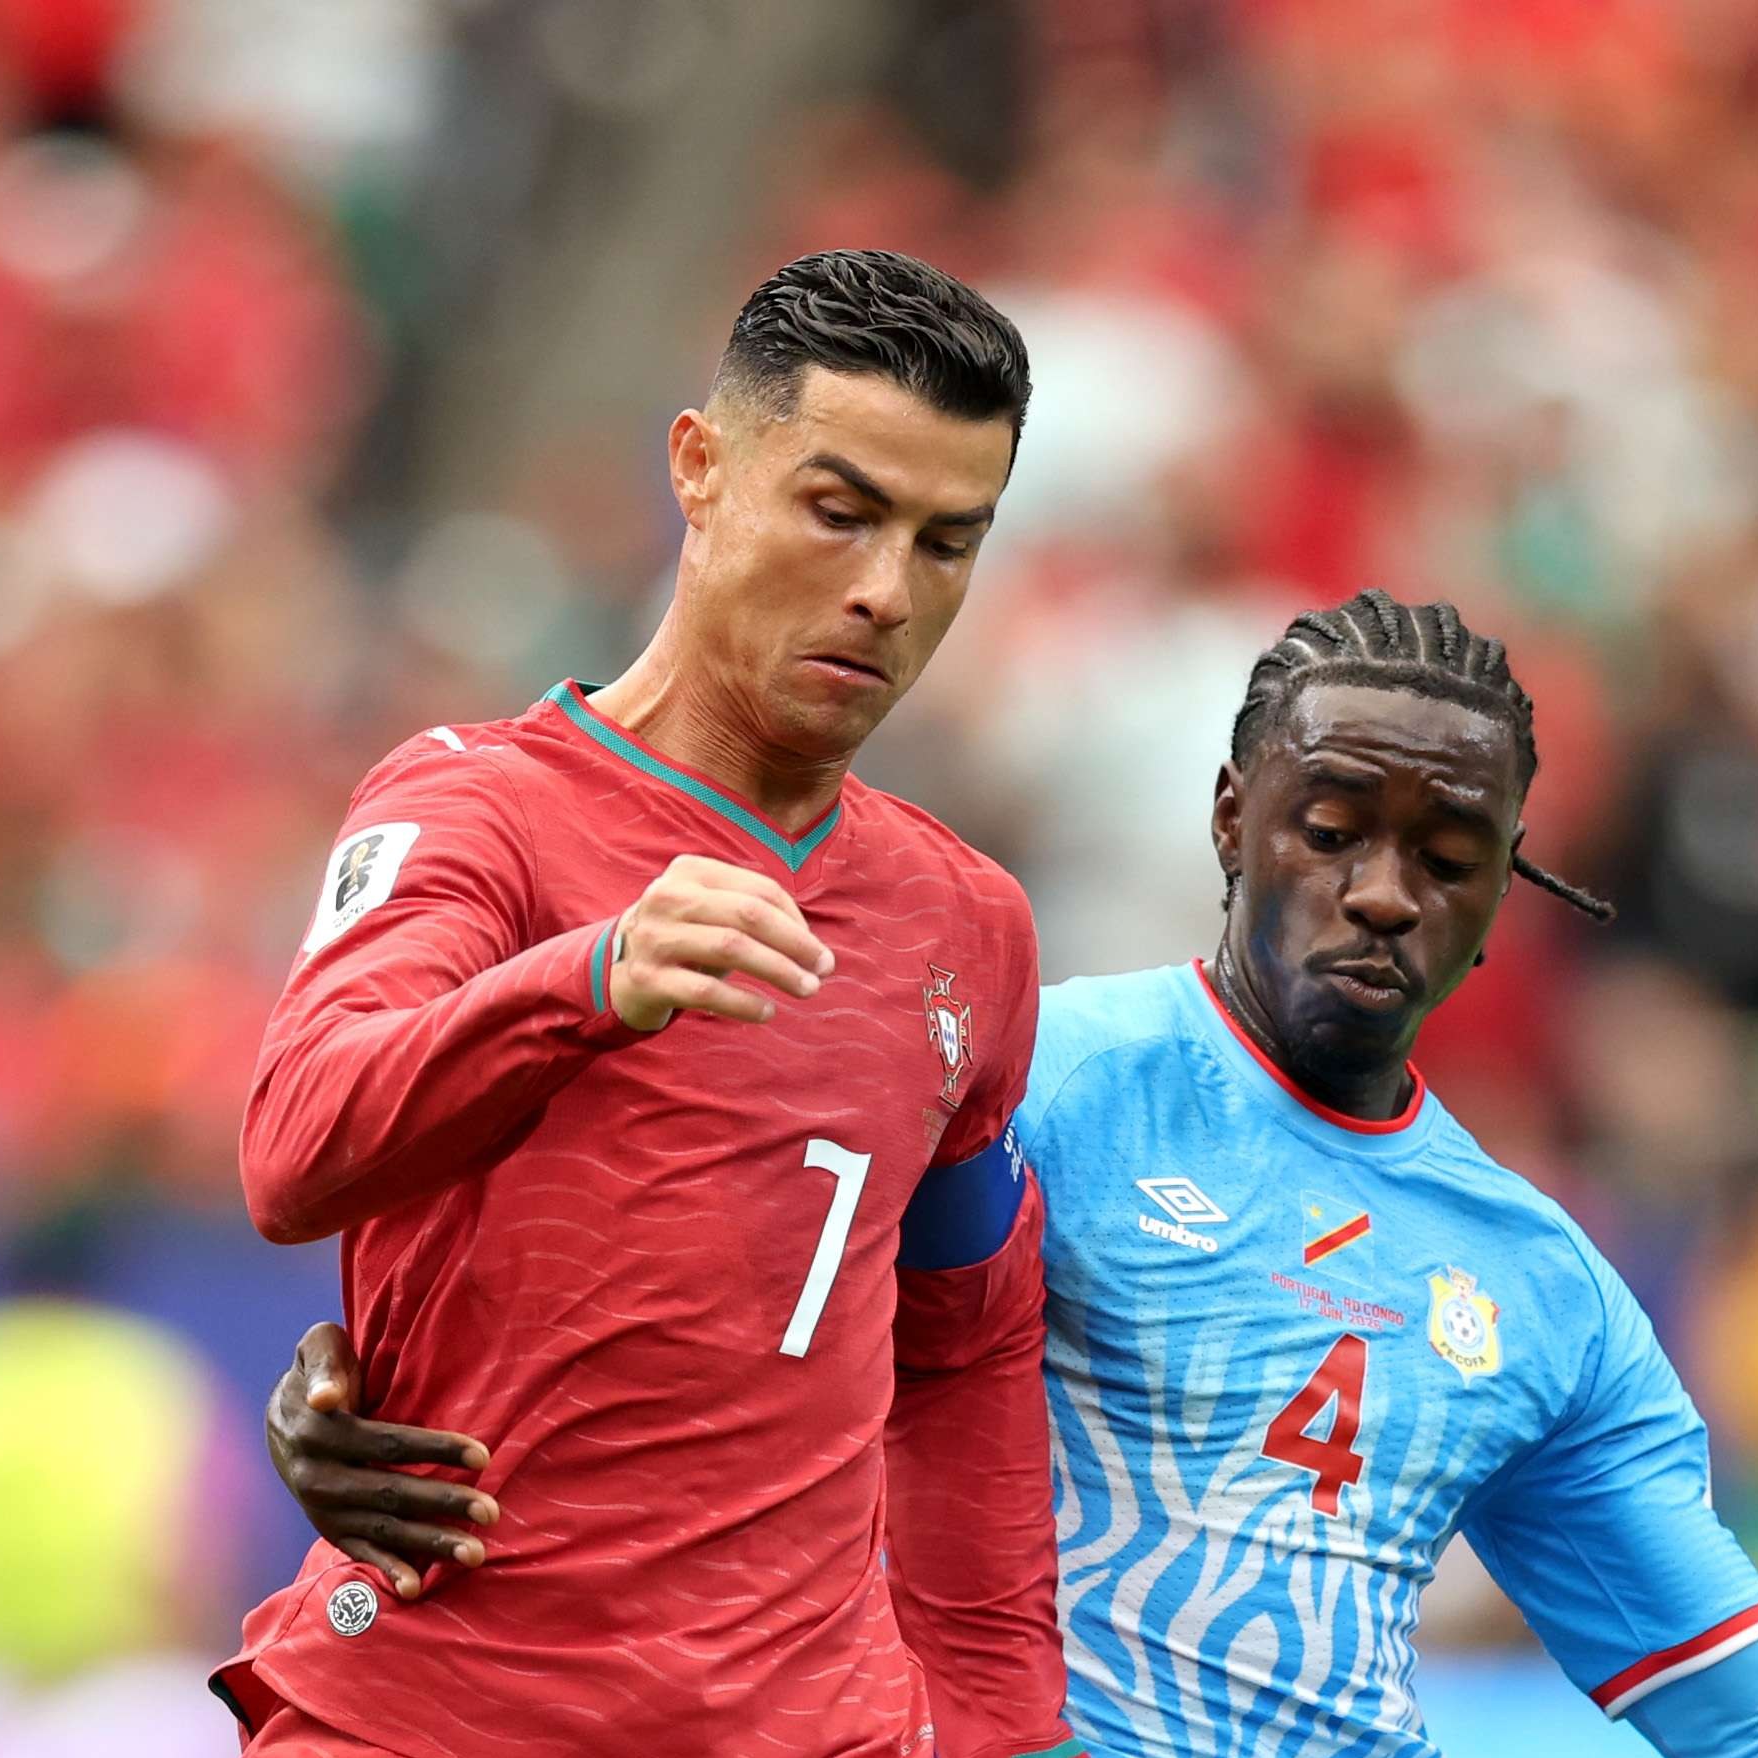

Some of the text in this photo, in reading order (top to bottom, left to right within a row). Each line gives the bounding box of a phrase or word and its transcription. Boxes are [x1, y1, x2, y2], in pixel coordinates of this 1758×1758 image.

[778, 1137, 872, 1359] 7
[1138, 1213, 1219, 1254] umbro
[1271, 1271, 1335, 1305] PORTUGAL
[1363, 1302, 1405, 1326] CONGO
[1318, 1303, 1342, 1321] JUIN
[1260, 1331, 1369, 1520] 4
